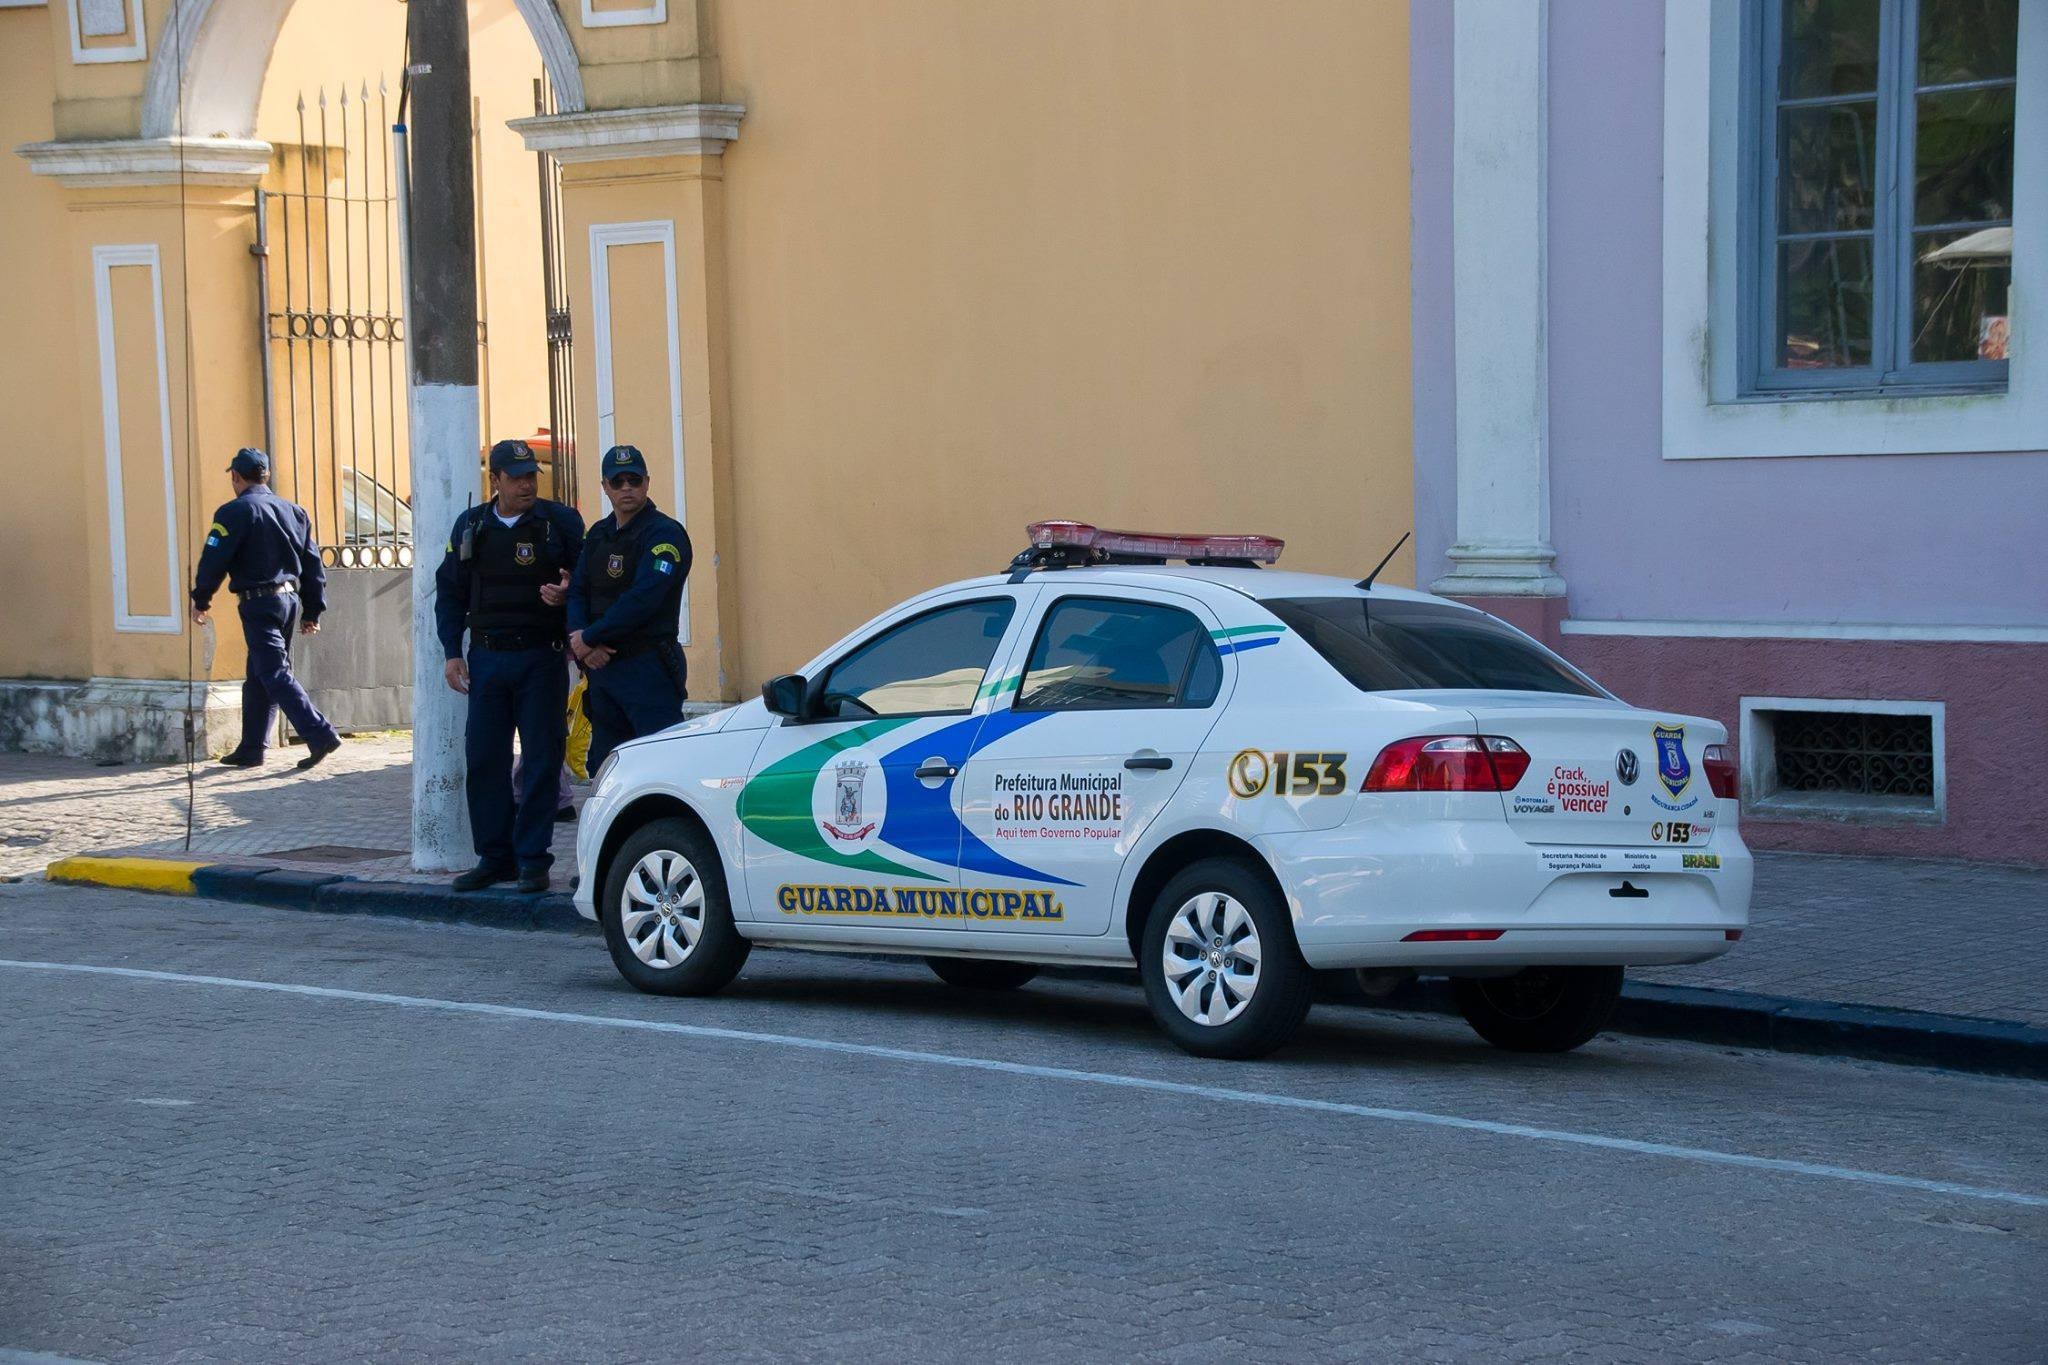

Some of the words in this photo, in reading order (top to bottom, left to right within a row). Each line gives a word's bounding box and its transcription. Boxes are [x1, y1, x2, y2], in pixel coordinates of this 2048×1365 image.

[1273, 752, 1347, 796] 153
[1554, 766, 1588, 782] Crack,
[995, 774, 1057, 791] Prefeitura
[1060, 773, 1122, 795] Municipal
[1547, 778, 1556, 795] é
[1558, 780, 1610, 800] possível
[994, 803, 1009, 820] do
[1014, 795, 1043, 821] RIO
[1049, 794, 1122, 821] GRANDE
[1513, 805, 1555, 813] VOYAGE
[1562, 798, 1608, 813] vencer
[996, 827, 1017, 840] Aqui
[1020, 827, 1038, 838] tem
[1040, 827, 1081, 838] Governo
[1084, 827, 1121, 840] Popular
[1666, 821, 1692, 843] 153
[1624, 852, 1650, 860] Ministério
[1682, 854, 1721, 869] BRASIL
[1549, 862, 1580, 870] Segurança
[1581, 861, 1602, 869] Pública
[776, 884, 893, 915] GUARDA
[893, 886, 1064, 920] MUNICIPAL
